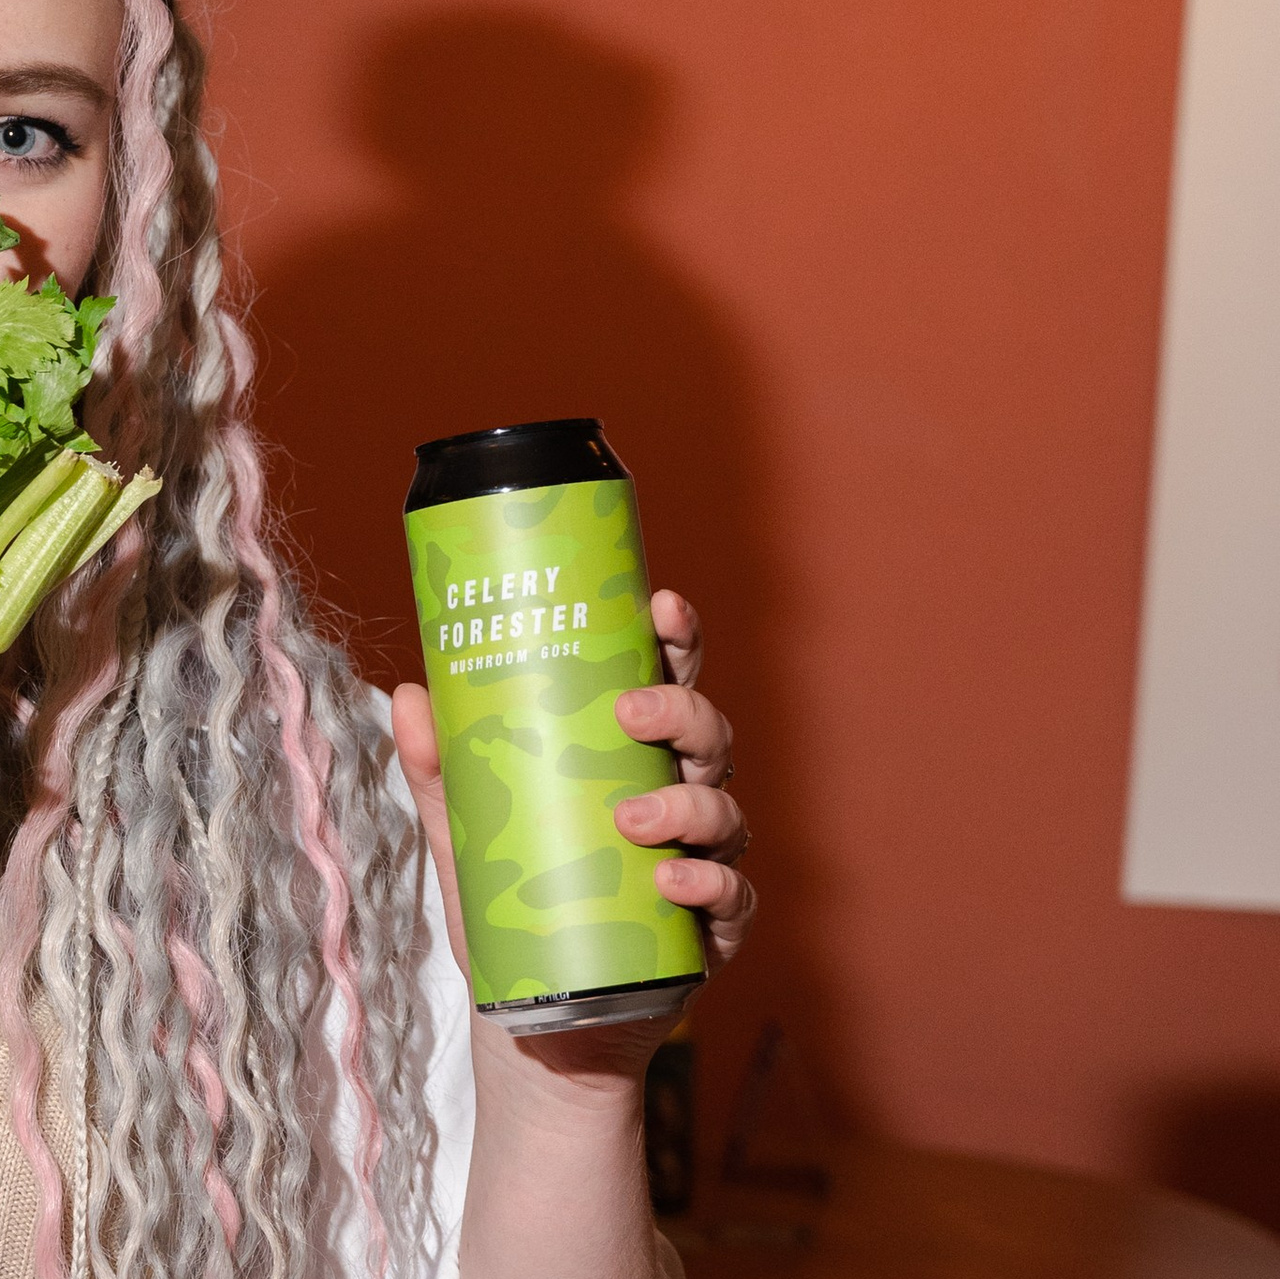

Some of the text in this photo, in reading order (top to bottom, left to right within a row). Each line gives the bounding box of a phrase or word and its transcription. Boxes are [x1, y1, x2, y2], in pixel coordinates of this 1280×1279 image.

[447, 567, 560, 610] CELERY
[440, 603, 588, 651] FORESTER
[450, 641, 581, 675] MUSHROOM GOSE
